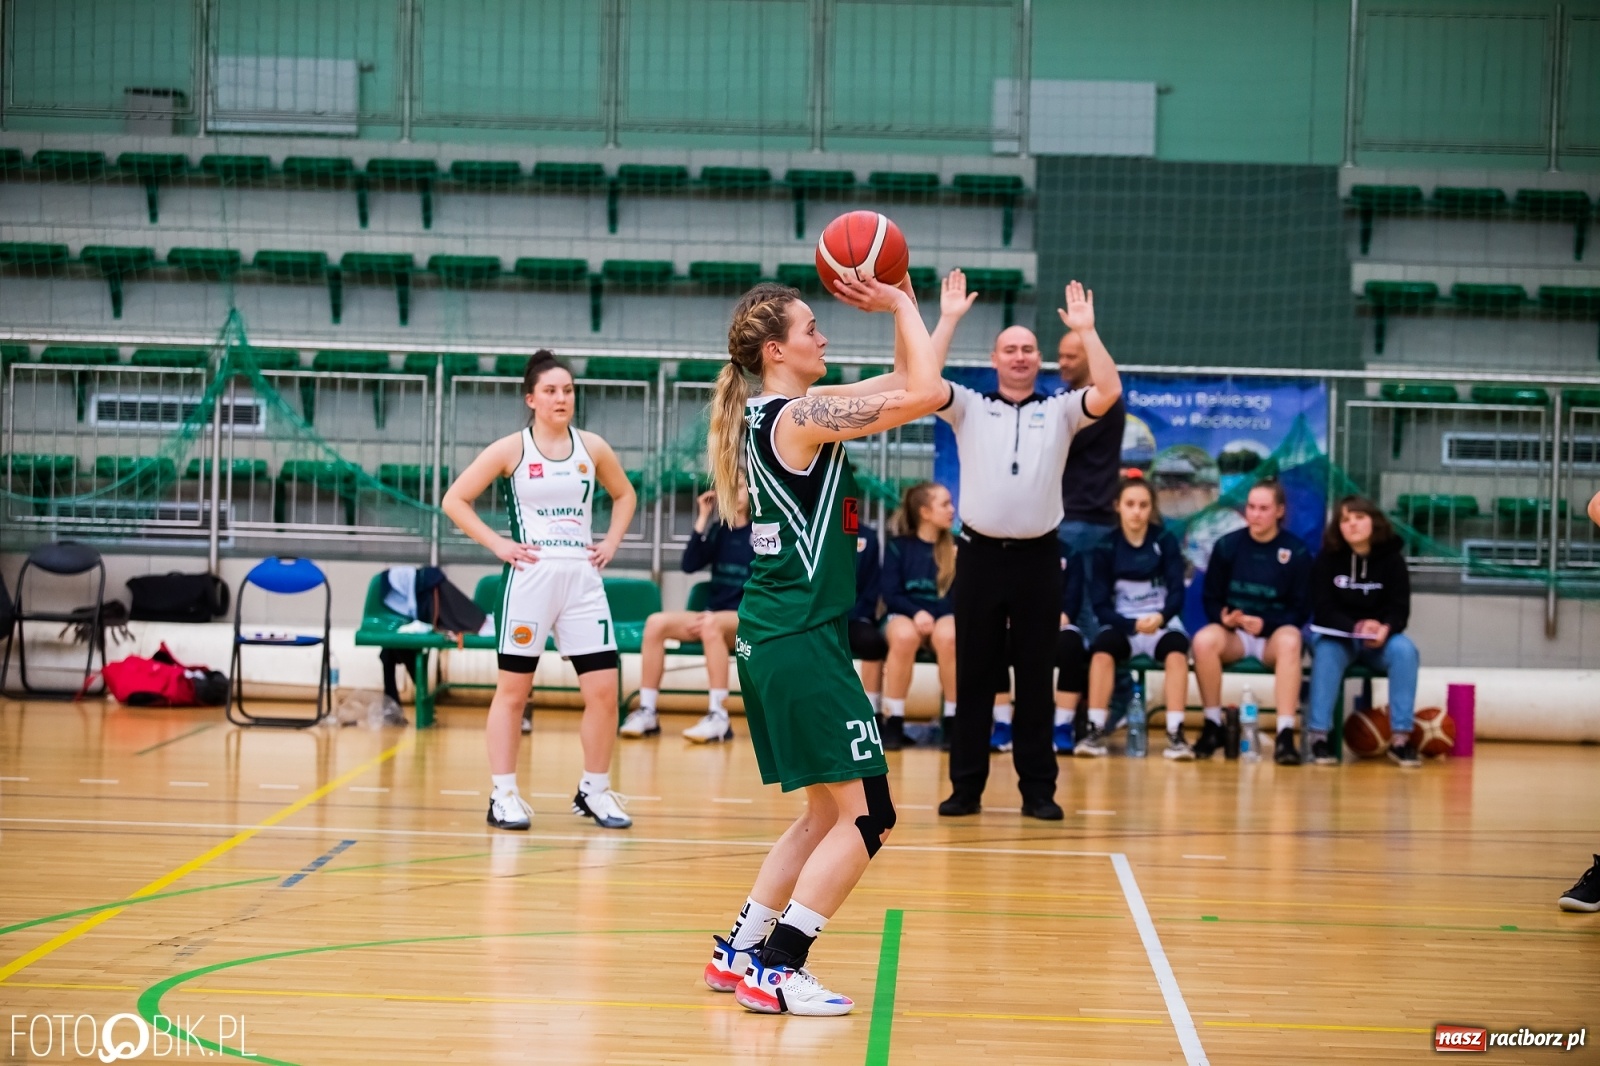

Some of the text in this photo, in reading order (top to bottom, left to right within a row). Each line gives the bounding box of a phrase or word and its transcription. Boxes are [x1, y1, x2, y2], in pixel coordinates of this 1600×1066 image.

[581, 480, 590, 504] 7
[598, 618, 610, 646] 7
[846, 716, 885, 762] 24
